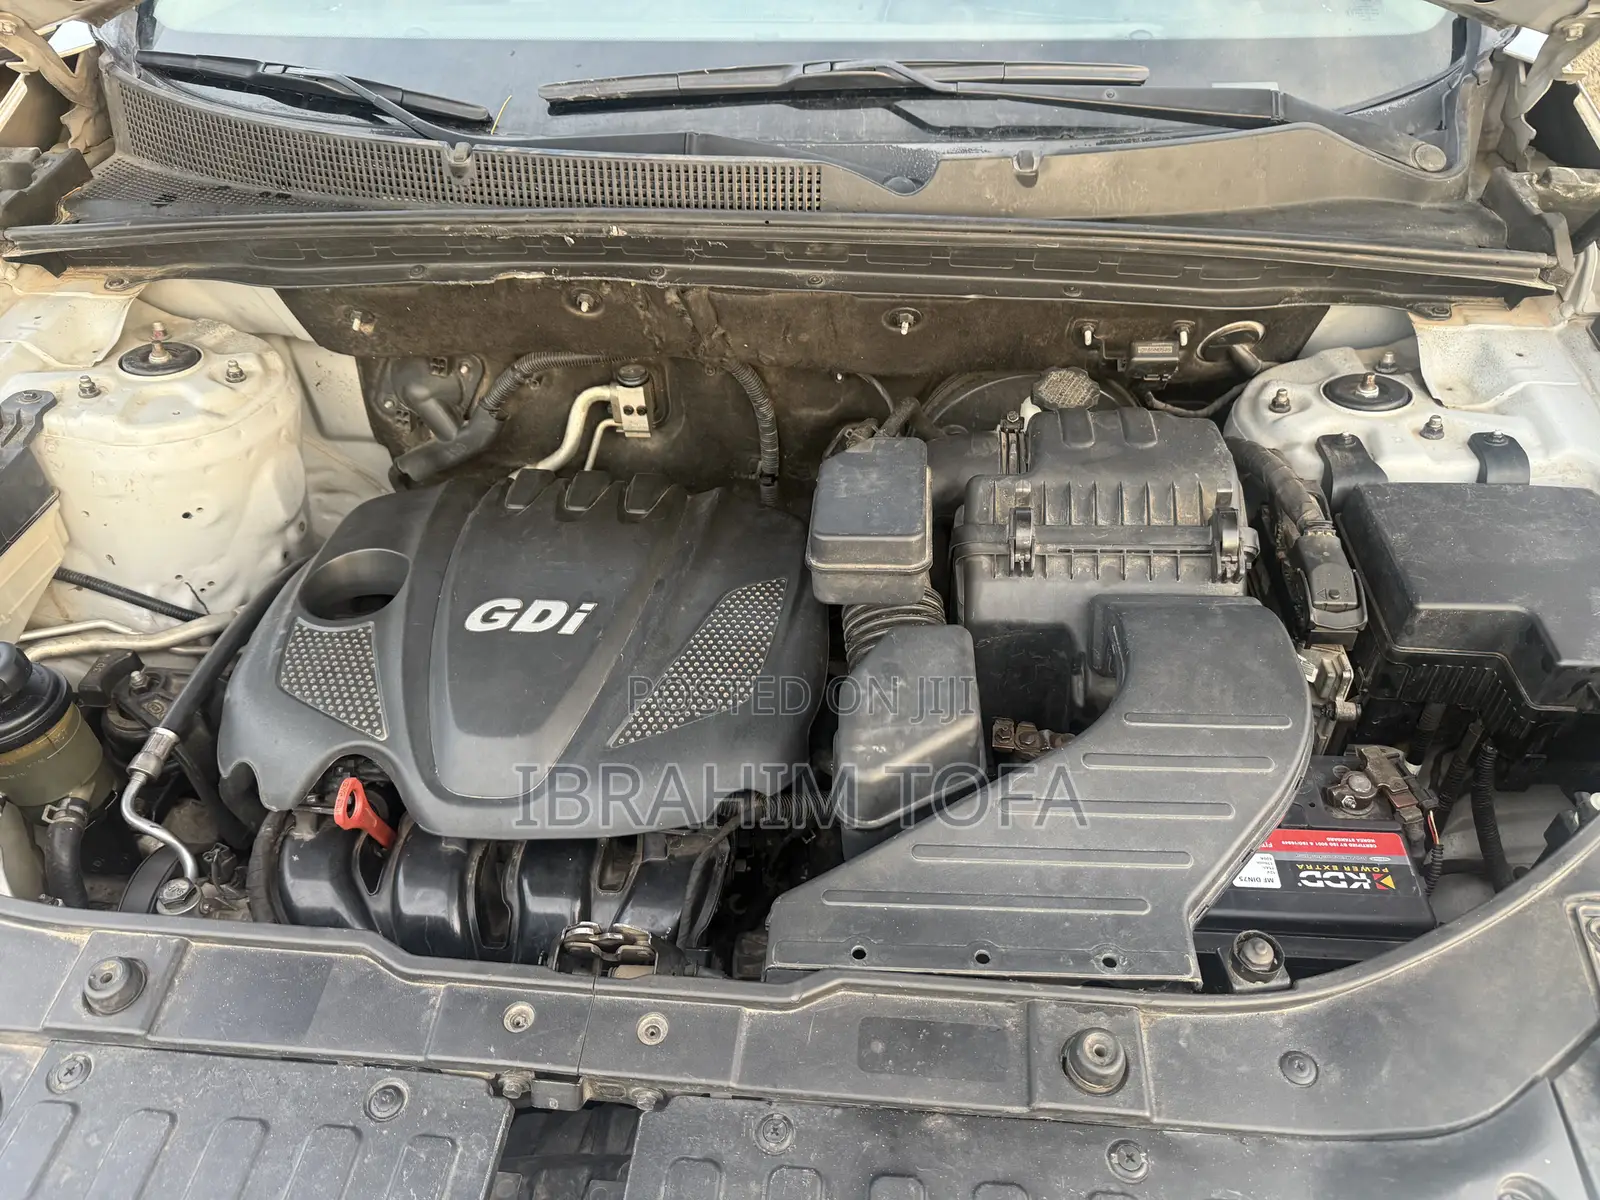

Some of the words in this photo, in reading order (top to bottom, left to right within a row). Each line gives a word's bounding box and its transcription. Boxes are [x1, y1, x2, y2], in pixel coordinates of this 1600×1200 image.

[464, 597, 598, 635] GDi
[1296, 863, 1339, 871] EXTRA
[1343, 865, 1389, 873] POWER
[1299, 870, 1372, 890] KDD
